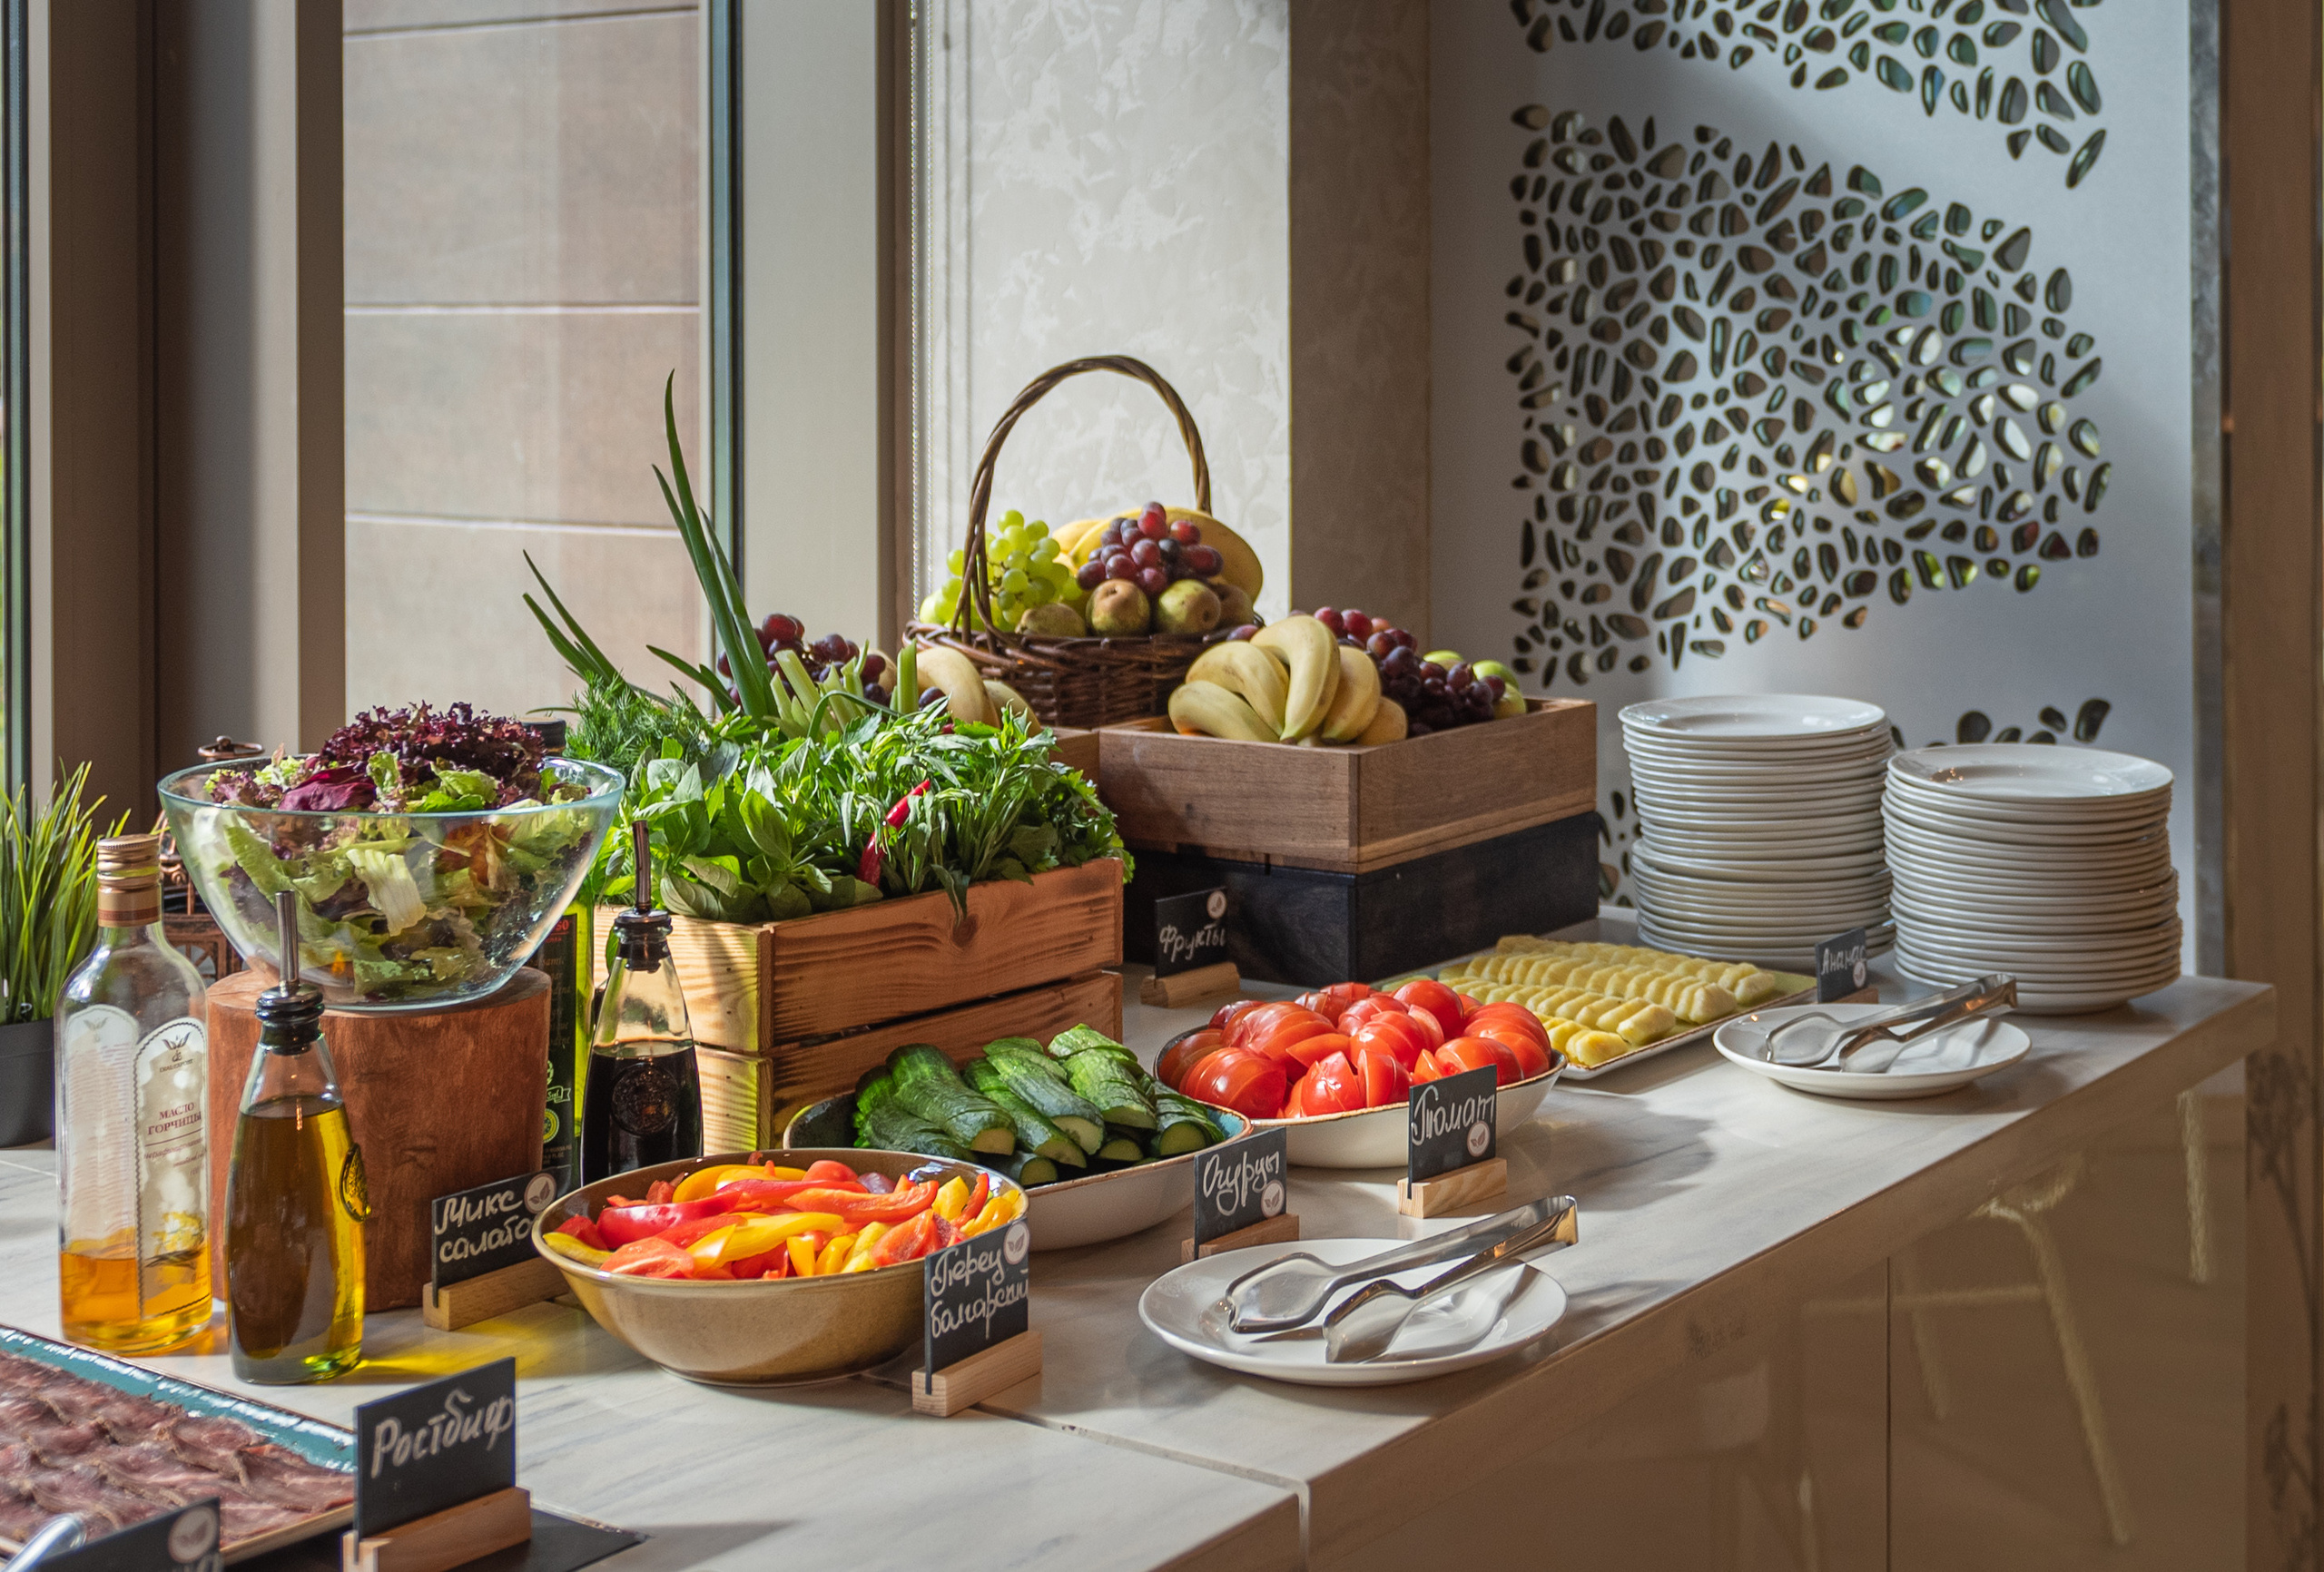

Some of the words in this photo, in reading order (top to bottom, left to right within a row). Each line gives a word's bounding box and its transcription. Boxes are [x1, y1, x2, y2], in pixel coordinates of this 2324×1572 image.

[147, 1111, 202, 1135] ГОРЧИЦЫ
[159, 1102, 195, 1120] МАСЛО
[1411, 1085, 1495, 1146] Томат
[1203, 1151, 1279, 1216] Огурцы
[434, 1190, 524, 1235] Микс
[439, 1214, 534, 1263] салато
[931, 1244, 1005, 1297] Перец
[370, 1389, 514, 1479] Ростбиф
